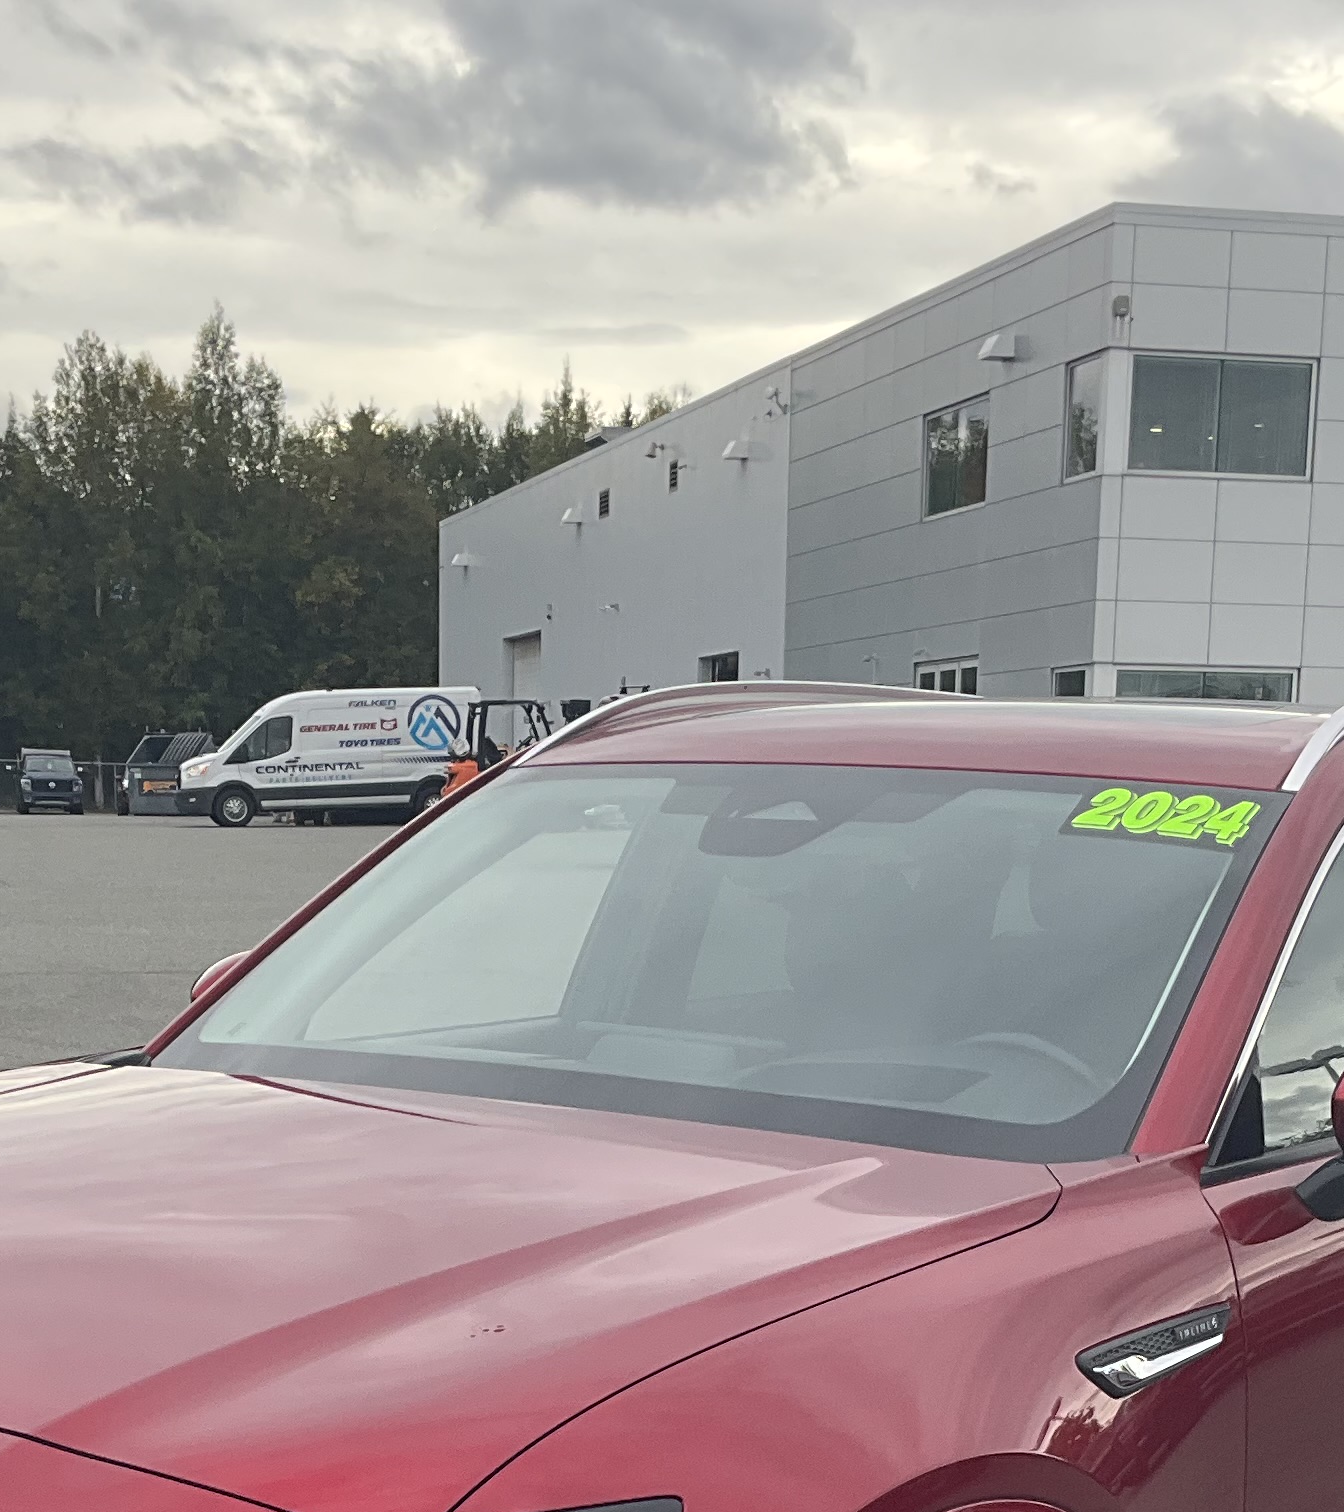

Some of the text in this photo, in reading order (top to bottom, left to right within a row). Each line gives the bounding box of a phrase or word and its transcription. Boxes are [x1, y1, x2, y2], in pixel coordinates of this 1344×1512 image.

[348, 699, 397, 710] FALKEN
[299, 722, 378, 733] GENERAL TIRE
[338, 737, 402, 748] TOYO TIRES
[255, 762, 365, 774] CONTINENTAL
[1071, 787, 1261, 847] 2024
